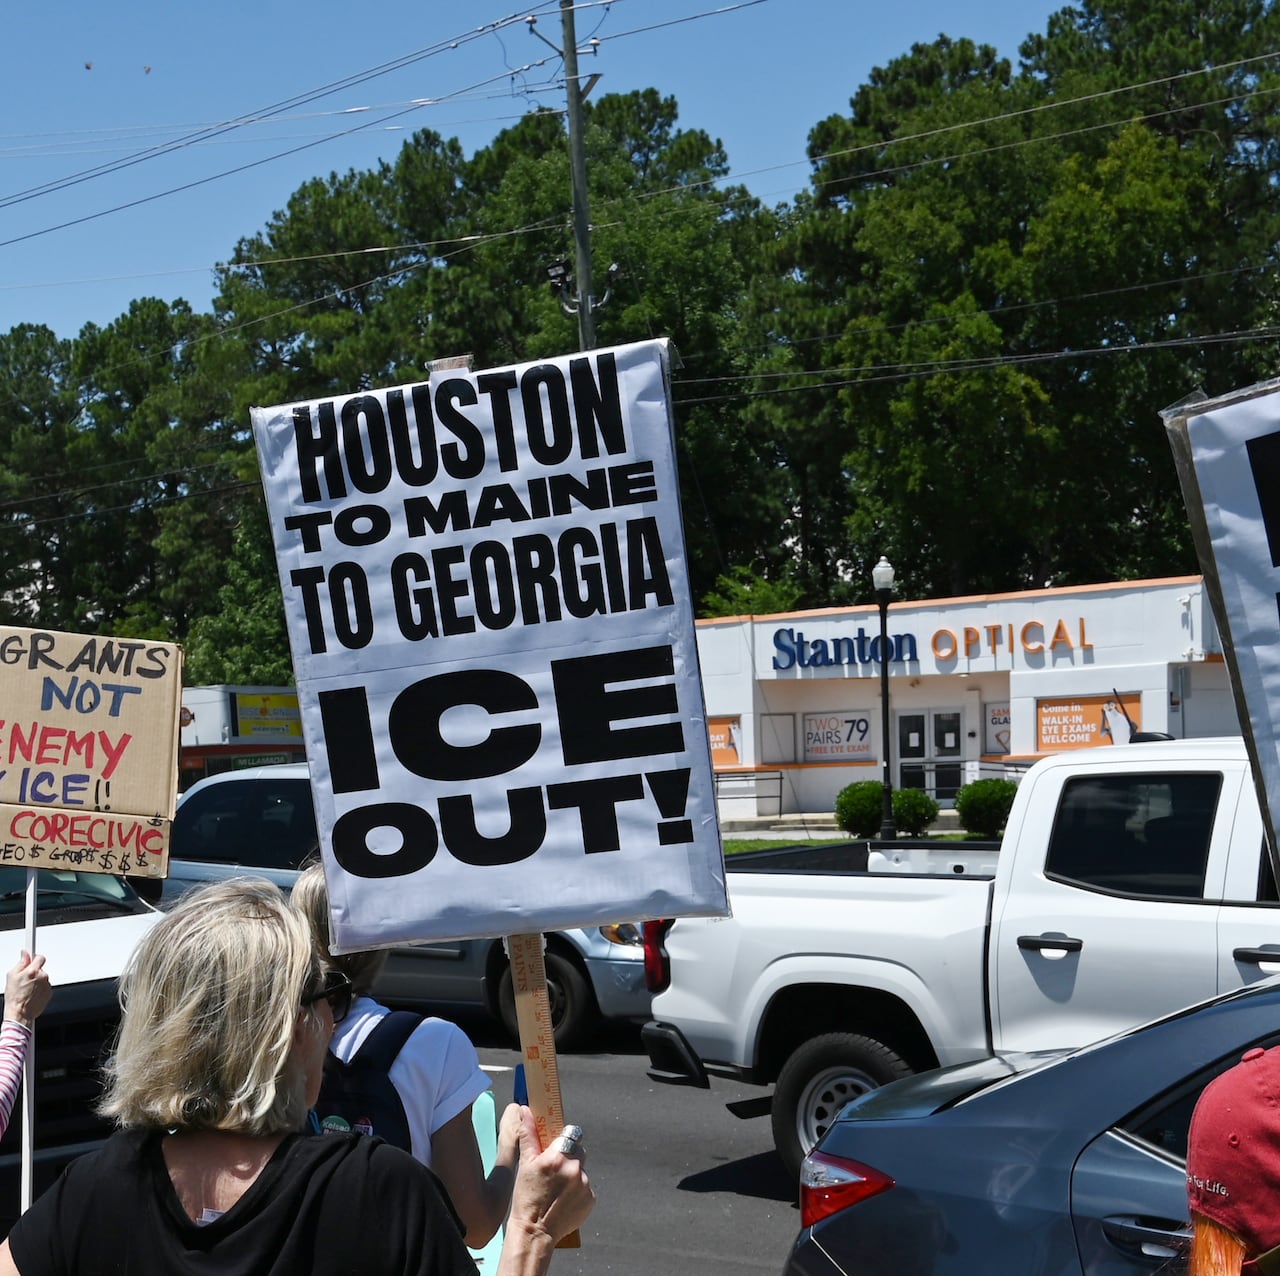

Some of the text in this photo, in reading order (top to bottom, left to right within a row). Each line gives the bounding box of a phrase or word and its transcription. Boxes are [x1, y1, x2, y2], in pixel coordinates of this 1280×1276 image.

[292, 353, 627, 503] HOUSTON
[285, 461, 658, 553] TO MAINE
[291, 516, 675, 654] TO GEORGIA
[772, 617, 1094, 670] Stanton OPTICAL
[41, 676, 142, 717] NOT
[1042, 703, 1069, 713] Come
[317, 645, 685, 794] ICE
[806, 719, 869, 745] PAIRS 79
[807, 717, 840, 731] TWO
[1042, 715, 1083, 725] WALK-IN
[1042, 724, 1096, 734] EYE EXAMS
[1042, 733, 1091, 744] WELCOME
[9, 811, 164, 855] CORECIVIC
[331, 768, 695, 878] OUT!
[513, 944, 528, 992] PAINTS
